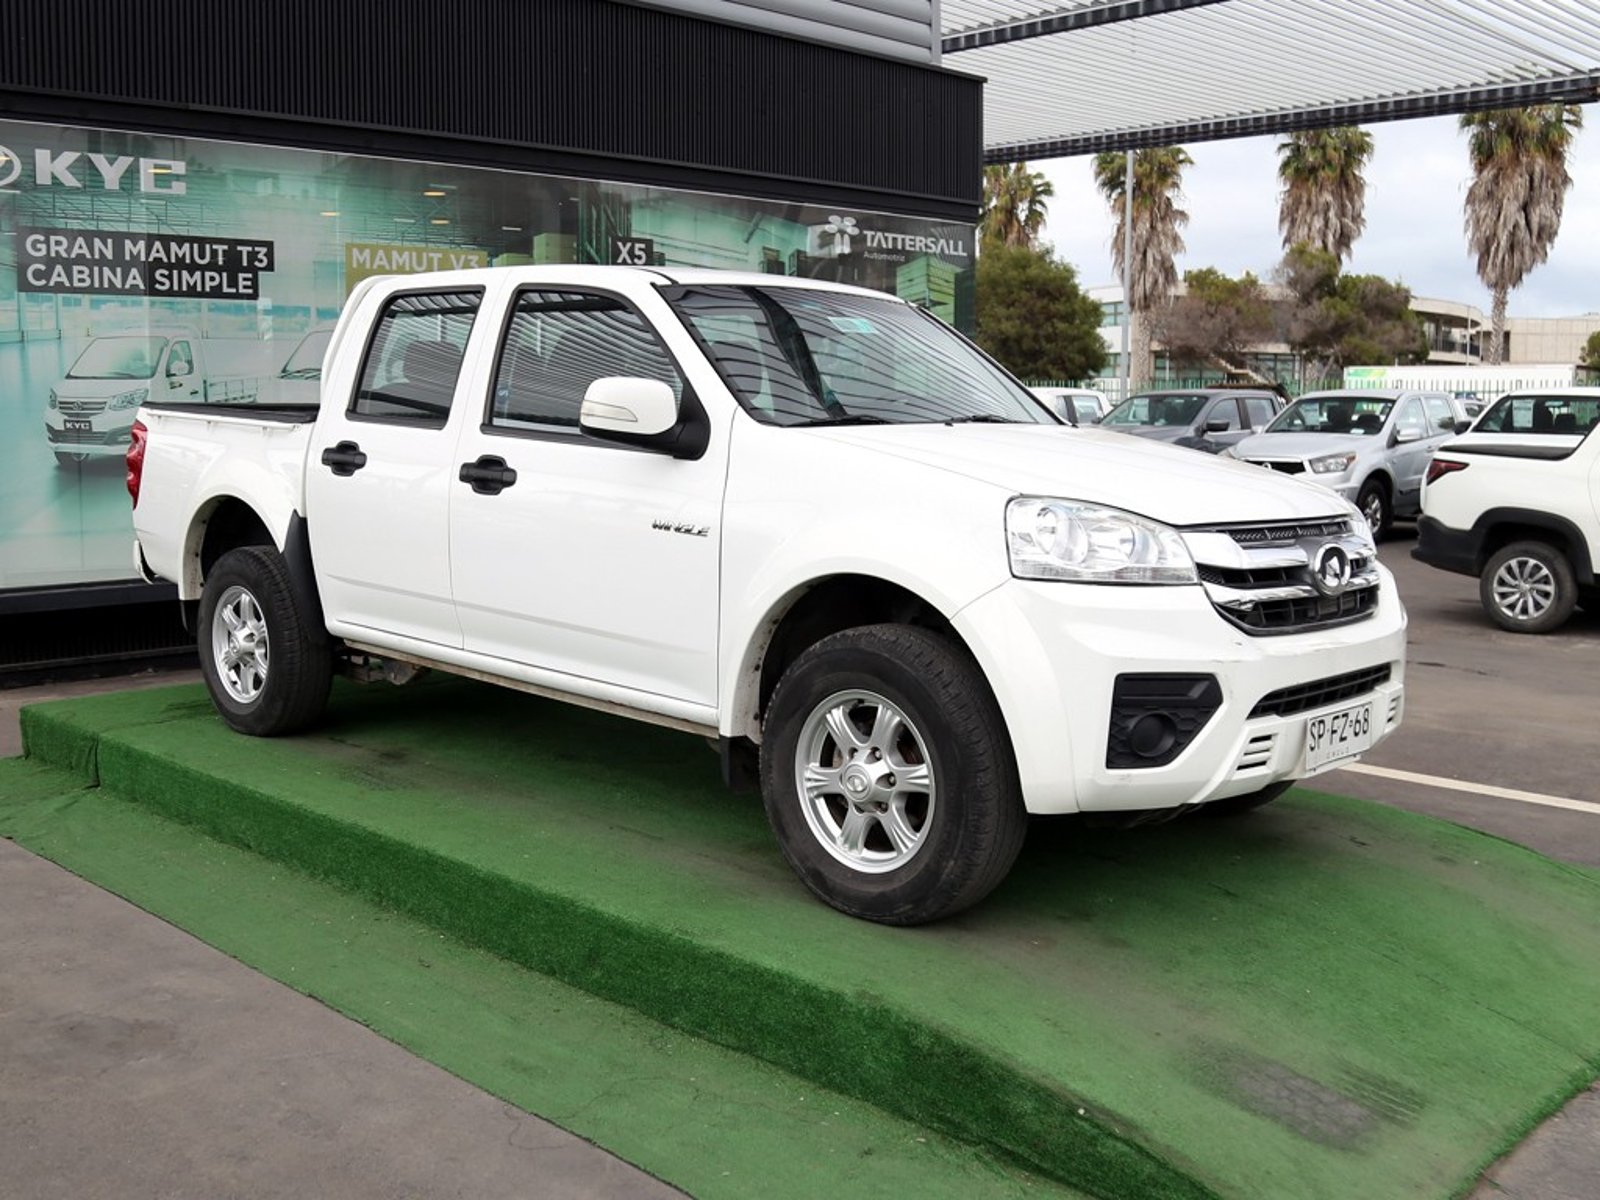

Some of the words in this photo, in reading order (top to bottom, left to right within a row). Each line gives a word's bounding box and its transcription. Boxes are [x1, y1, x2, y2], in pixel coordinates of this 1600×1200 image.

[34, 148, 187, 195] KYC
[25, 234, 113, 260] GRAN
[124, 239, 228, 265] MAMUT
[237, 245, 268, 268] T3
[616, 241, 647, 265] X5
[863, 230, 968, 257] TATTERSALL
[352, 247, 443, 272] MAMUT
[26, 263, 146, 289] CABINA
[154, 270, 254, 294] SIMPLE
